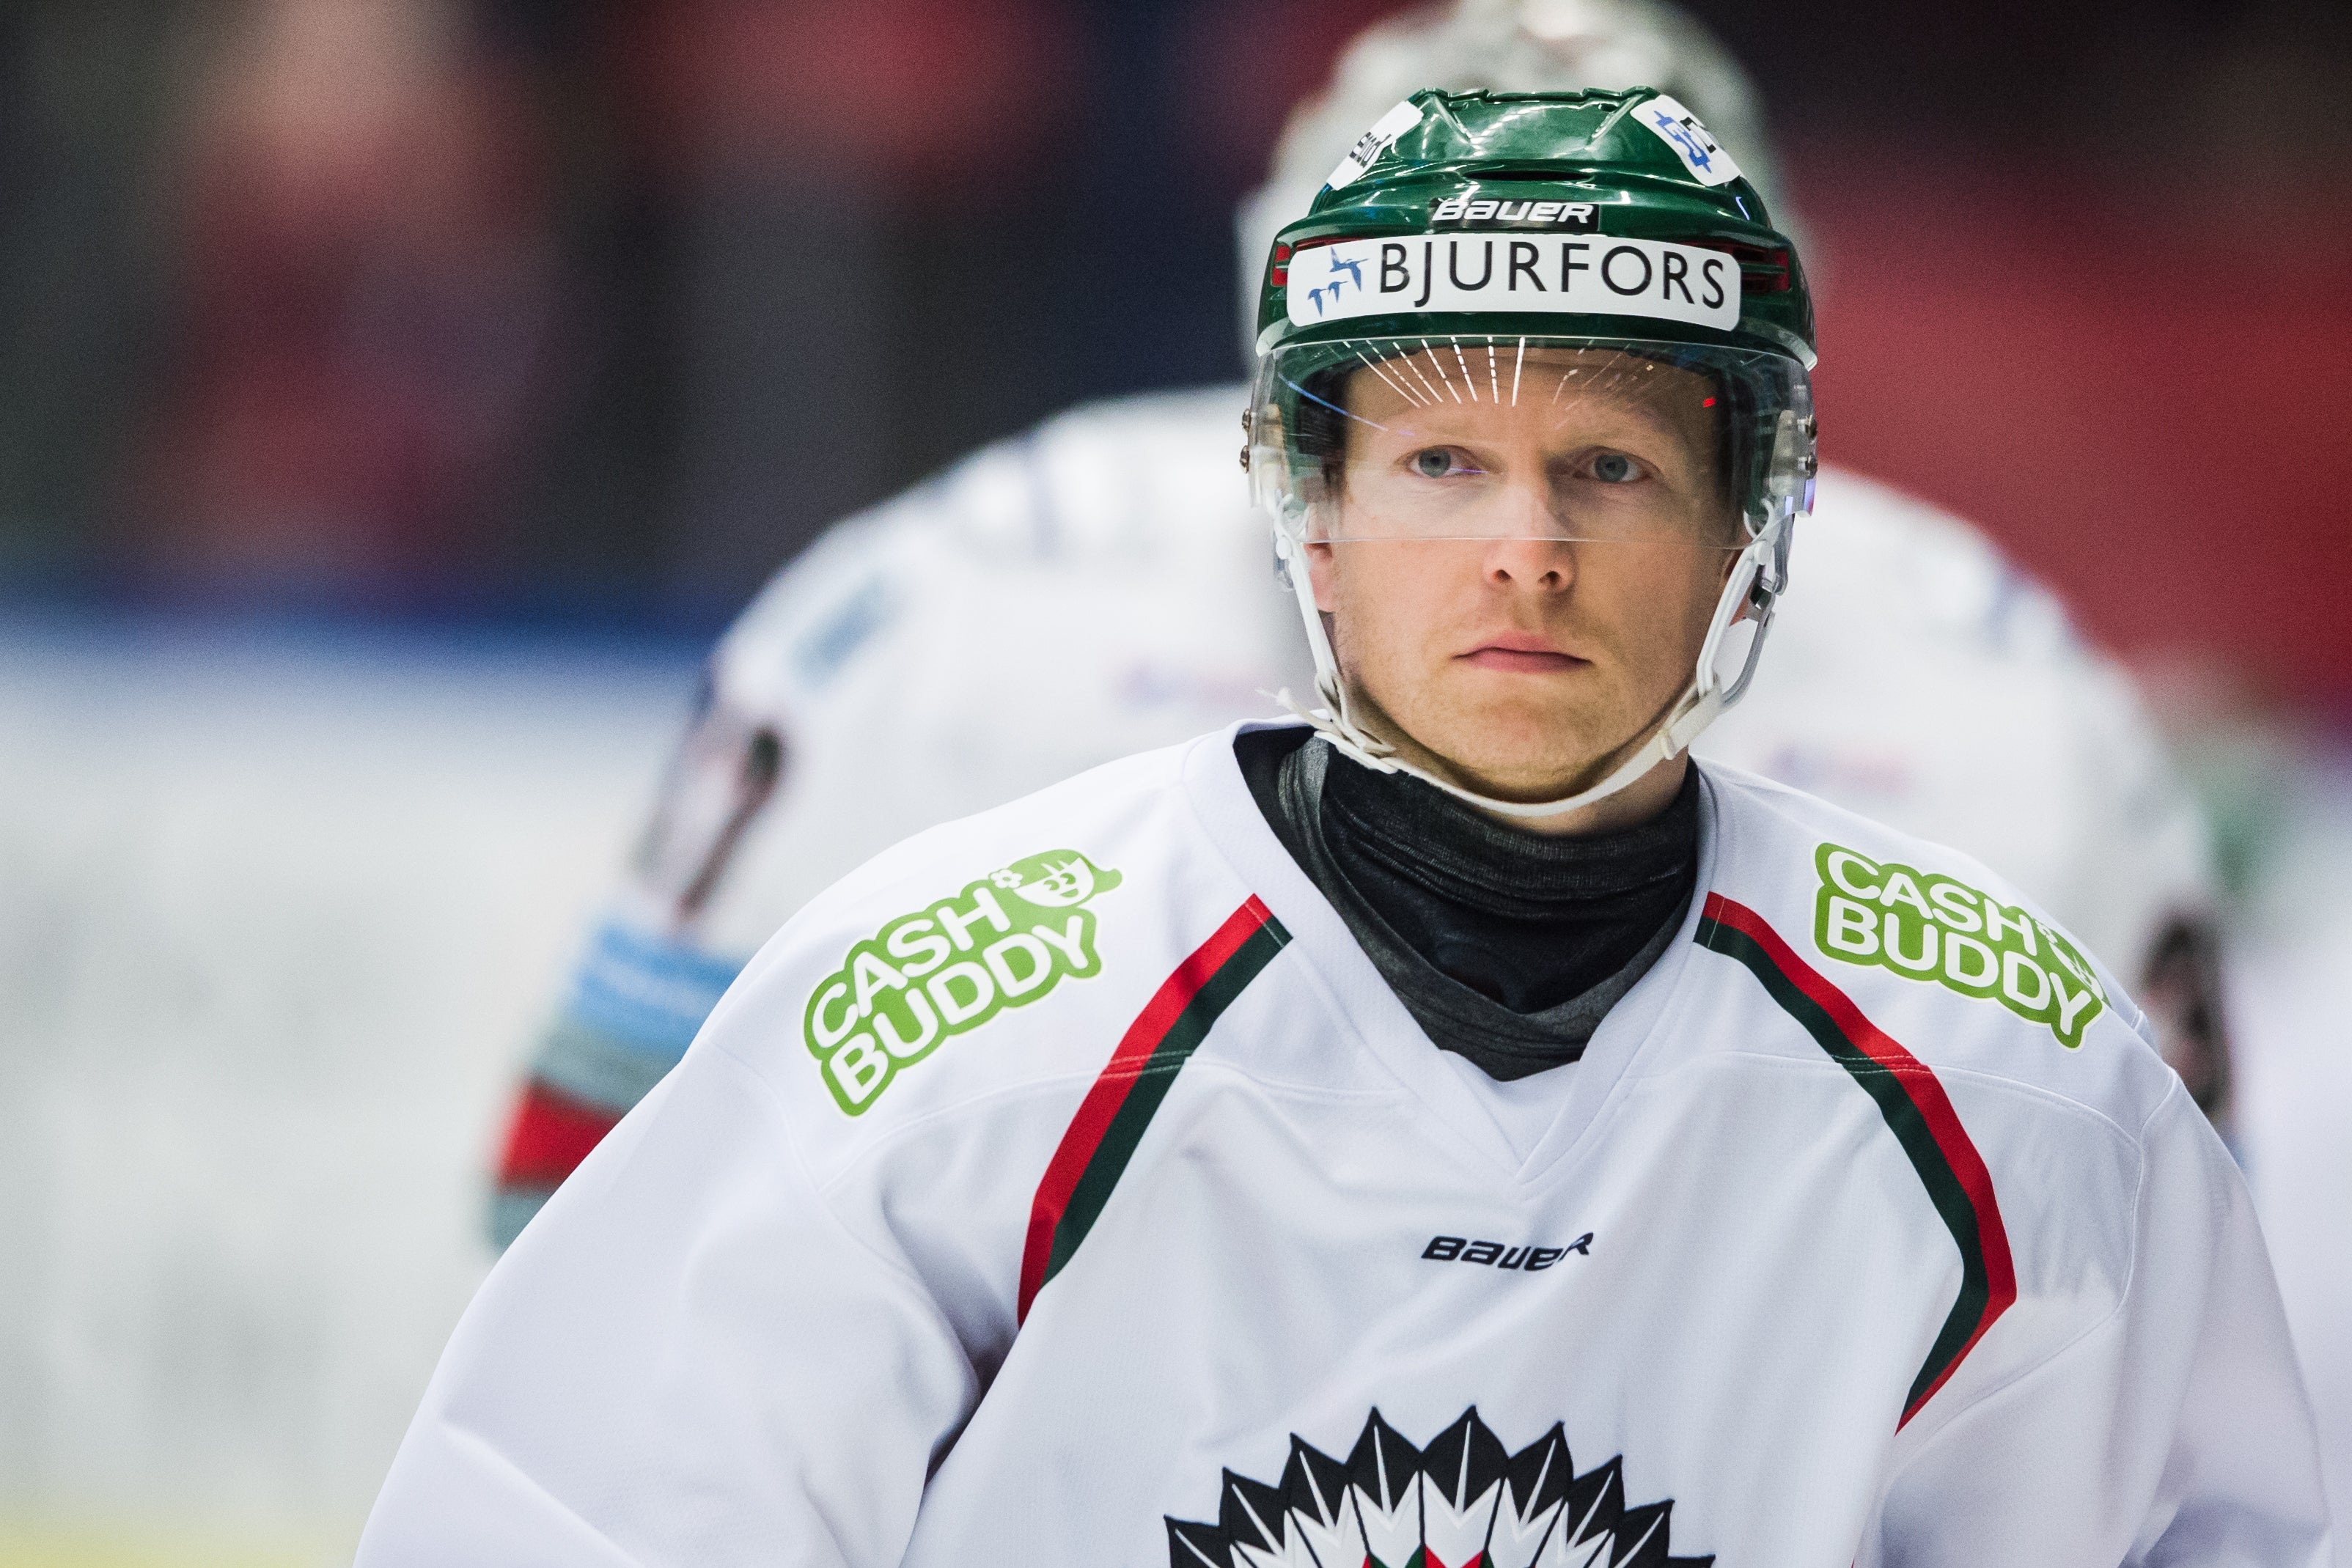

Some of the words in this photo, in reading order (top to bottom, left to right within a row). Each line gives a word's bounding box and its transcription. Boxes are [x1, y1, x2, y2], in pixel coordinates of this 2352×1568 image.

[1379, 240, 1725, 309] BJURFORS
[812, 886, 1012, 1048] CASH
[1826, 850, 2037, 957] CASH
[1826, 895, 2092, 1036] BUDDY
[828, 914, 1089, 1105] BUDDY
